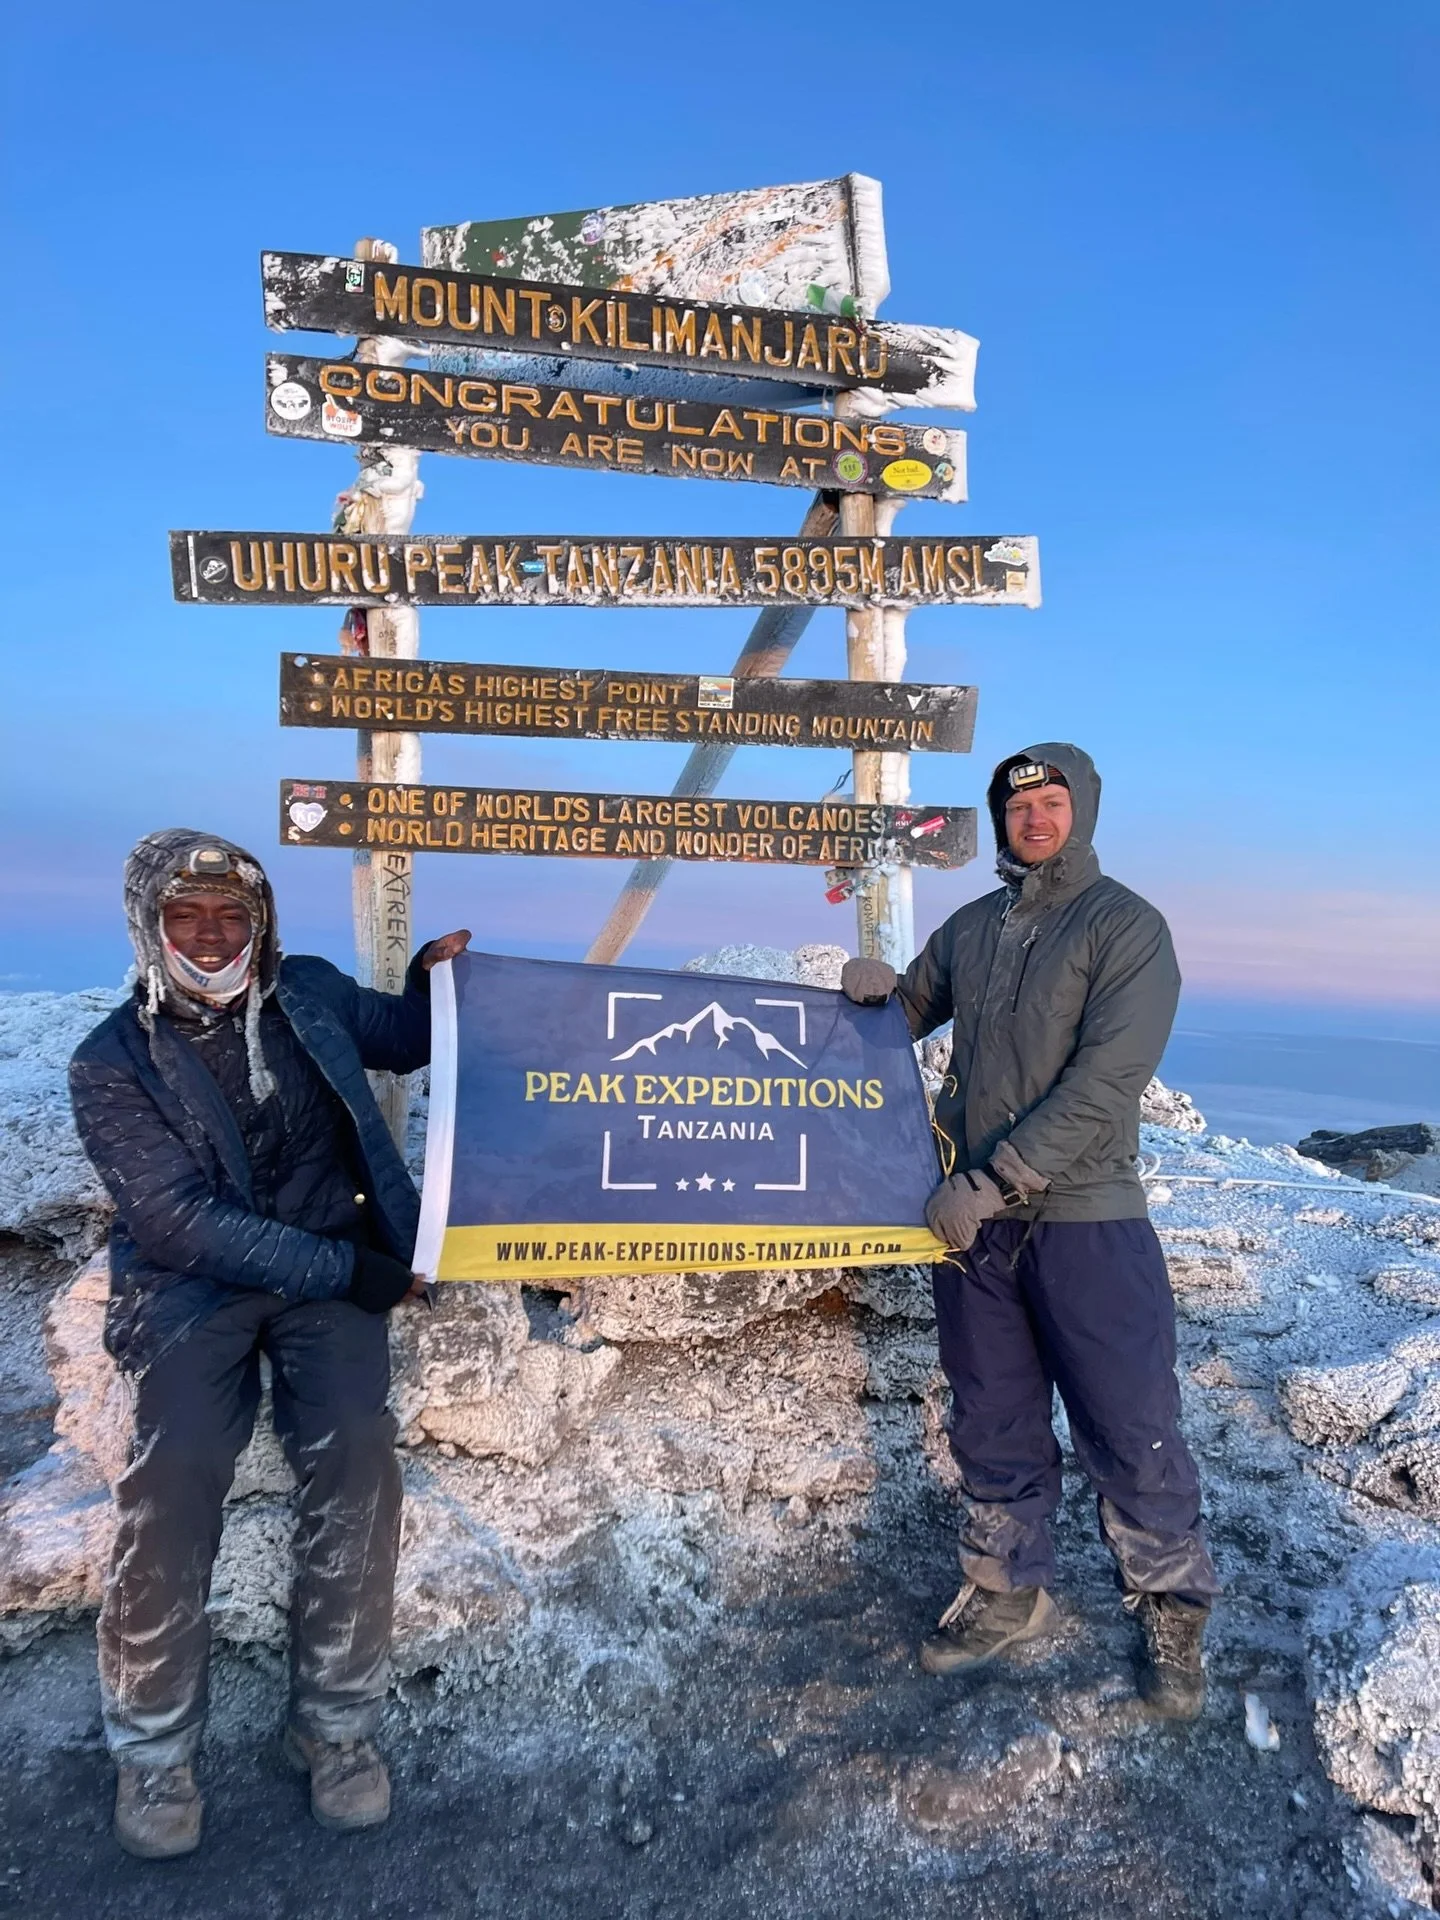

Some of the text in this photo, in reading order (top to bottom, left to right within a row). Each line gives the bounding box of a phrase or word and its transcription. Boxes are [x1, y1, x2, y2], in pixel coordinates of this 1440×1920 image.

[374, 271, 888, 379] MOUNT KILIMANJARO
[319, 364, 906, 456] CONGRATULATIONS
[446, 418, 530, 451] YOU
[560, 432, 644, 464] ARE
[672, 444, 754, 477] NOW
[780, 456, 826, 480] AT
[230, 540, 391, 593] UHURU
[405, 544, 522, 593] PEAK
[536, 544, 741, 595] TANZANIA
[754, 546, 886, 595] 5895M
[333, 668, 687, 705] AFRICAS HIGHEST POINT
[331, 695, 455, 723] WORLD'S
[465, 702, 590, 729] HIGHEST
[812, 715, 935, 743] MOUNTAIN
[367, 788, 884, 834] ONE OF WORLD'S LARGEST VOLCANOES
[366, 818, 465, 846] WORLD
[471, 822, 606, 852] HERITAGE
[615, 827, 665, 854] AND
[675, 830, 774, 858] WONDER
[782, 833, 811, 859] OF
[525, 1071, 884, 1109] PEAK EXPEDITIONS
